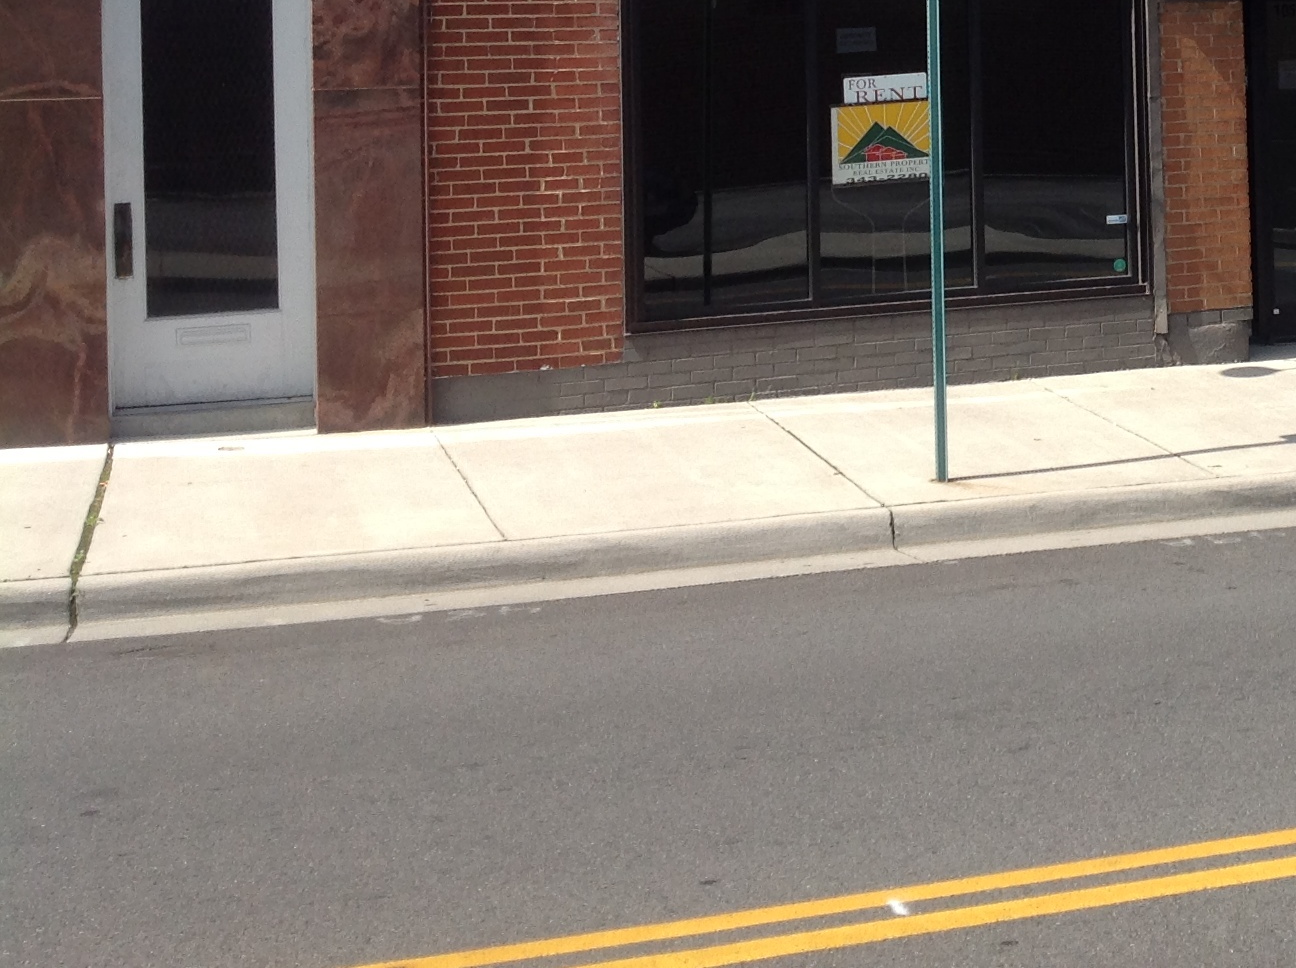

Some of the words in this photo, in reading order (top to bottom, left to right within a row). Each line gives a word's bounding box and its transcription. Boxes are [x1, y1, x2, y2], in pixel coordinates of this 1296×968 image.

[848, 78, 877, 90] FOR
[855, 86, 923, 103] RENT
[838, 162, 887, 171] SOUTHERN
[890, 159, 929, 168] PROPERT
